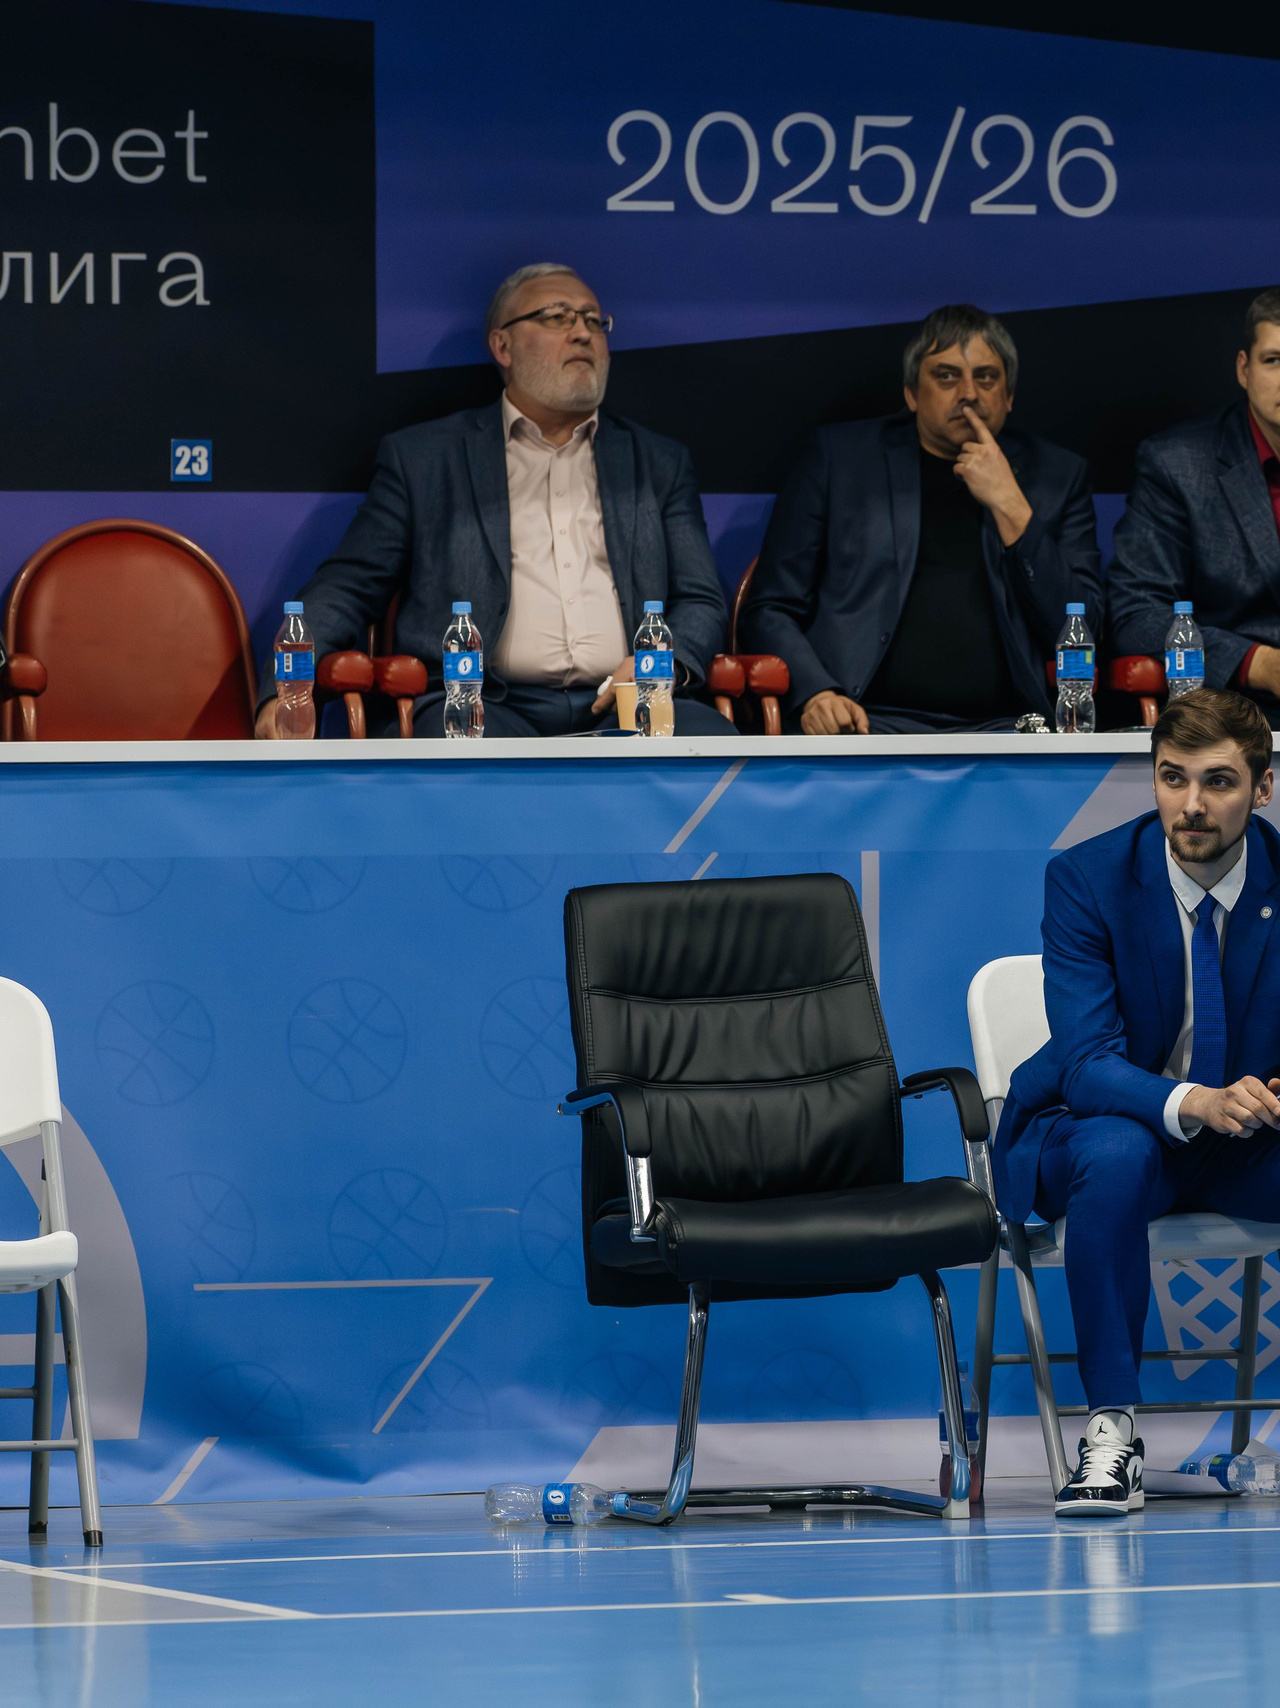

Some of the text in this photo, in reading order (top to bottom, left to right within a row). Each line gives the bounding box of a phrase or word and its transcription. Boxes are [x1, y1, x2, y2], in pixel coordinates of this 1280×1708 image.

[606, 106, 1118, 224] 2025/26
[0, 251, 211, 307] лига
[174, 445, 209, 476] 23
